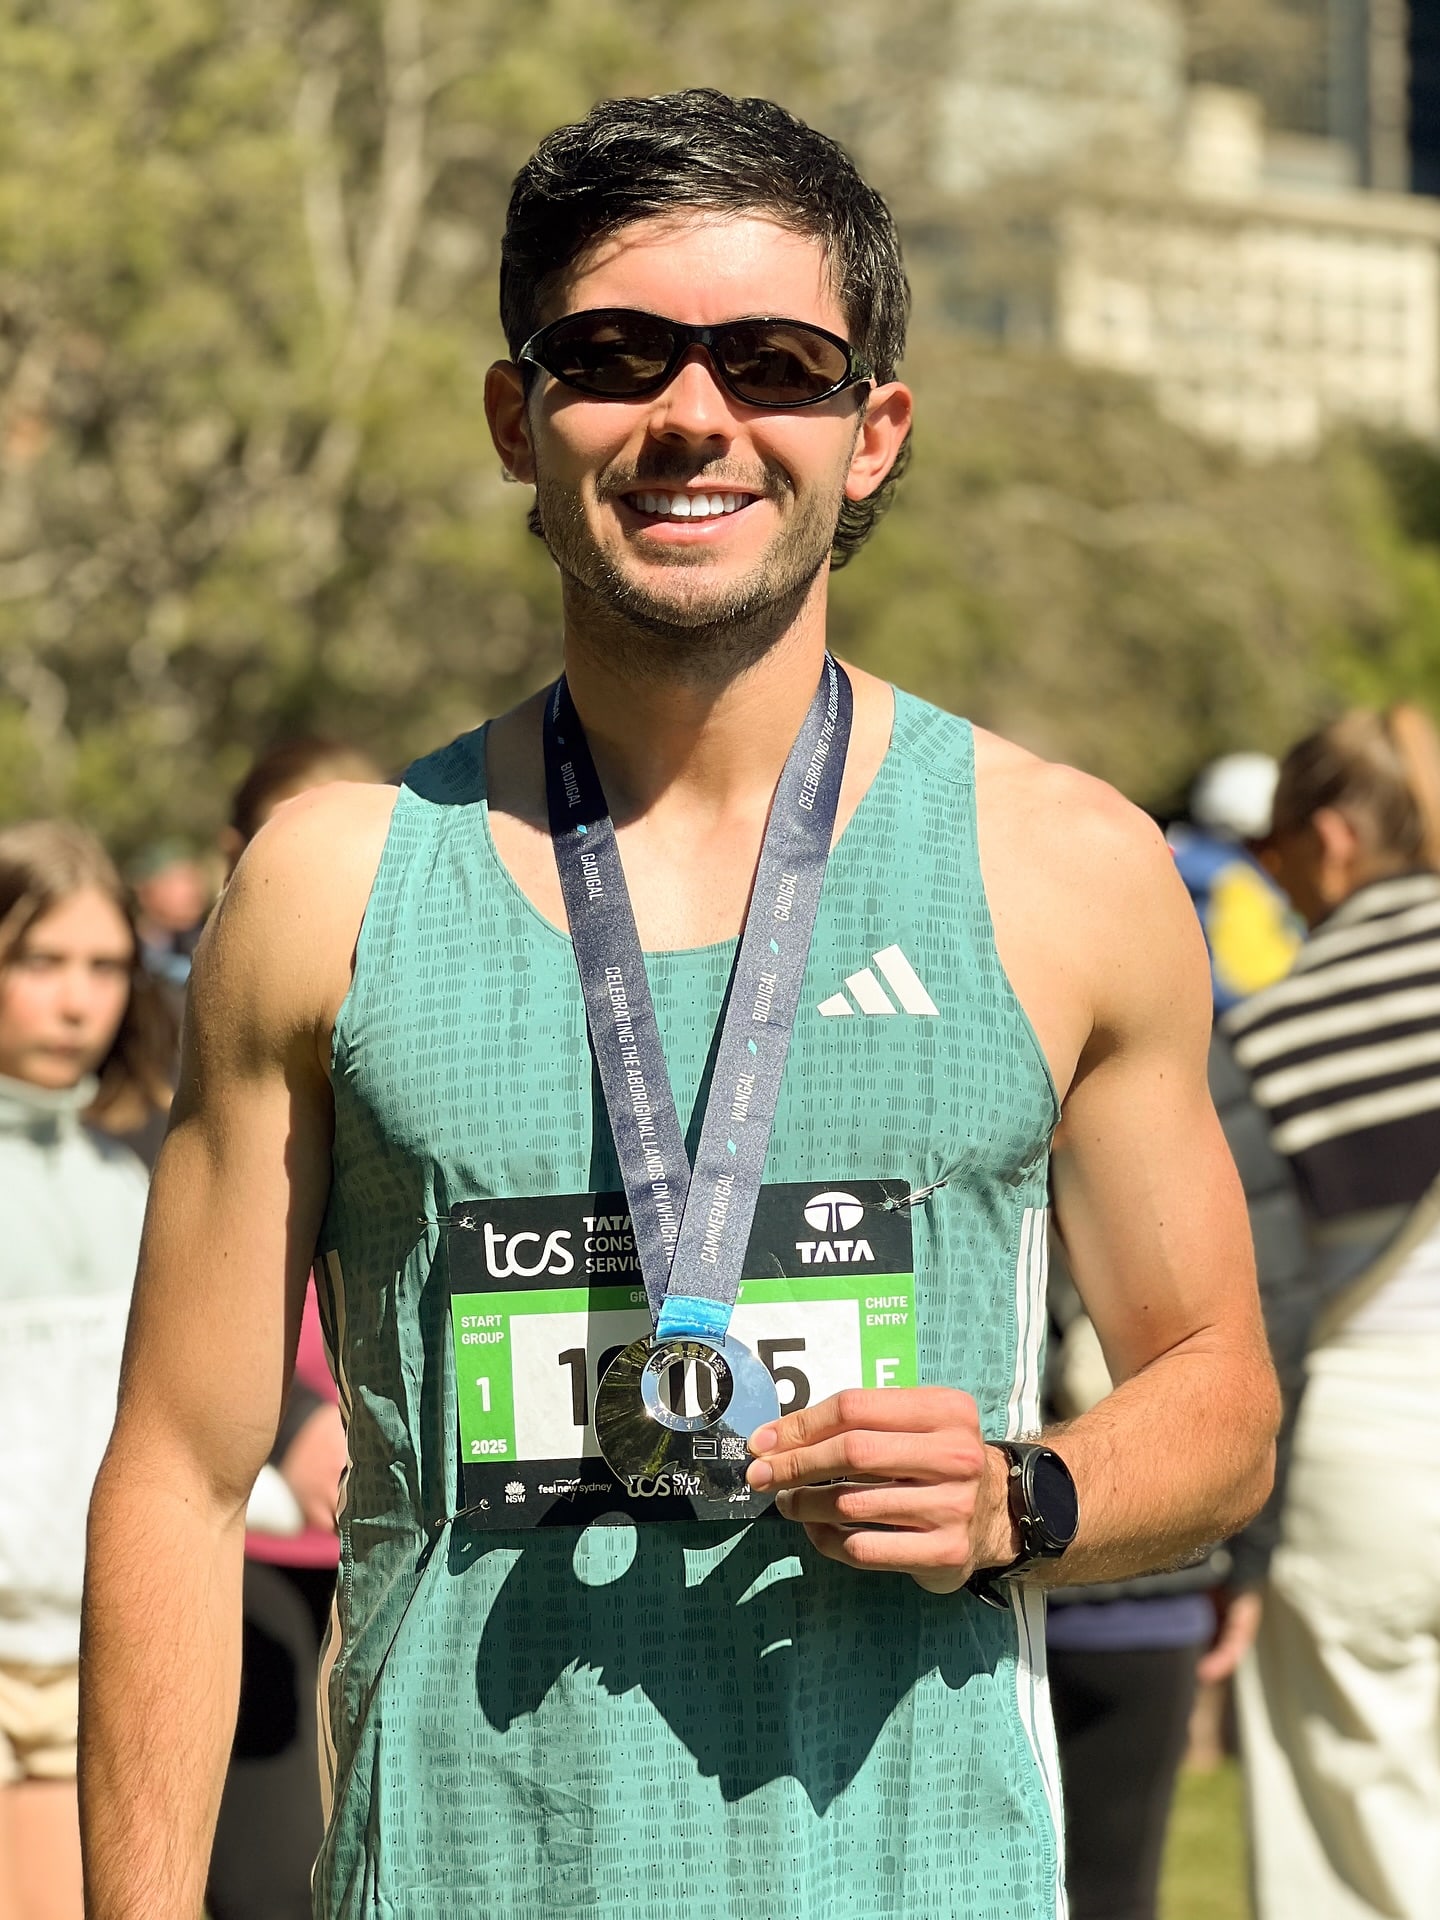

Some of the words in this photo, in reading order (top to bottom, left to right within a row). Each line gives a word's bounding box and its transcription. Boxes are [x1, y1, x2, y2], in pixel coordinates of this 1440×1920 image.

[798, 739, 830, 811] CELEBRATING
[820, 718, 836, 741] THE
[560, 761, 582, 809] BIDJIGAL
[580, 853, 605, 901] GADIGAL
[774, 873, 798, 921] GADIGAL
[605, 966, 635, 1043] CELEBRATING
[752, 970, 777, 1023] BIDJIGAL
[621, 1043, 639, 1068] THE
[627, 1068, 656, 1140] ABORIGINAL
[731, 1072, 756, 1123] WANGAL
[644, 1140, 666, 1181] LANDS
[652, 1182, 668, 1200] ON
[655, 1200, 678, 1242] WHICH
[701, 1172, 736, 1263] CAMMERAYGAL
[483, 1222, 575, 1278] tcs
[585, 1257, 642, 1273] SERVIC
[795, 1239, 876, 1264] TATA
[865, 1296, 909, 1309] CHUTE
[866, 1313, 909, 1326] ENTRY
[461, 1315, 503, 1328] START
[461, 1332, 505, 1344] GROUP
[875, 1358, 900, 1389] E
[476, 1376, 491, 1412] 1
[471, 1439, 508, 1455] 2025
[505, 1494, 526, 1504] NSW
[538, 1484, 557, 1494] feel
[557, 1484, 578, 1494] new
[579, 1482, 612, 1494] sydney
